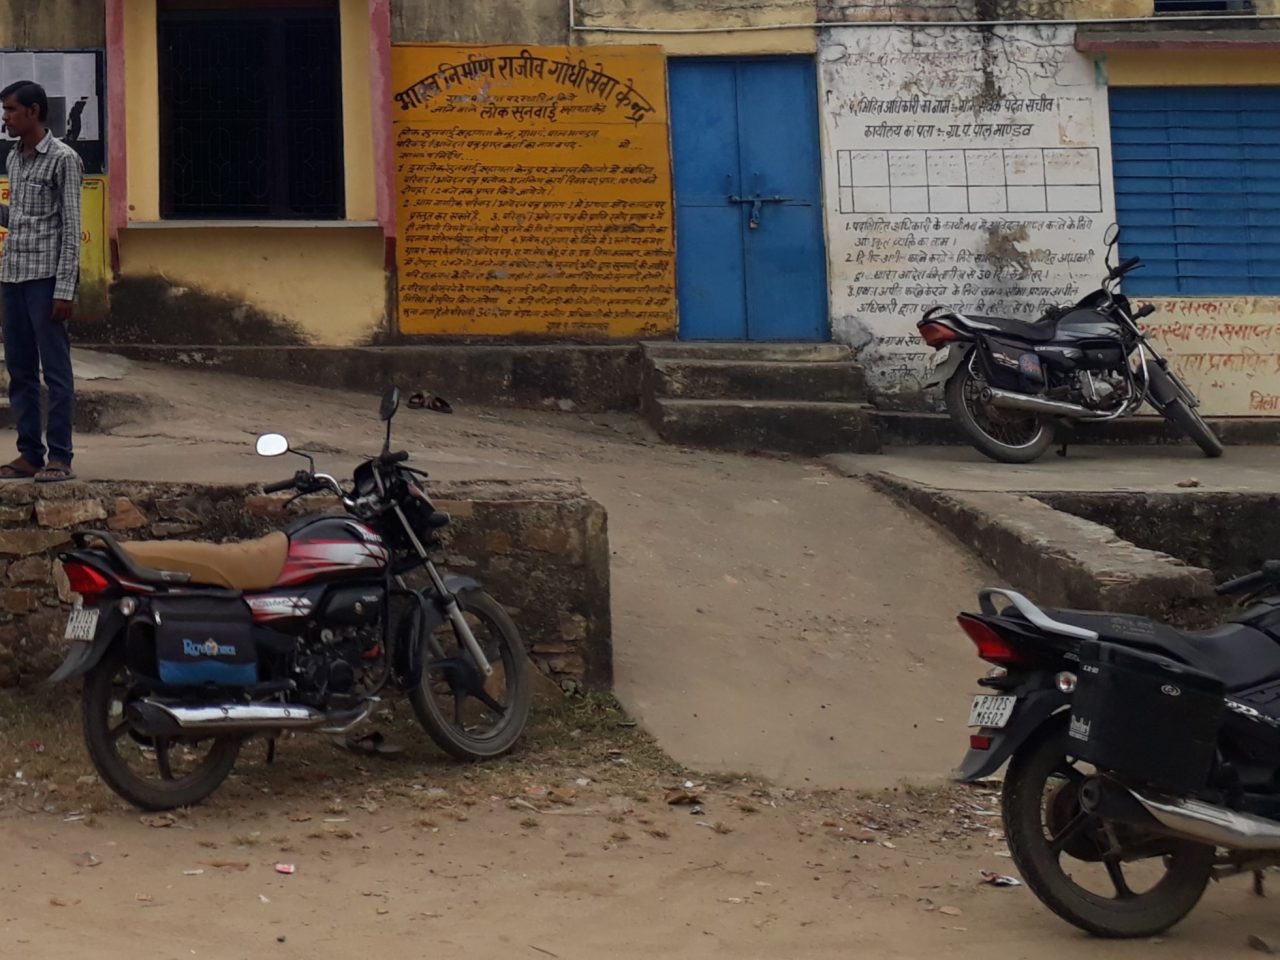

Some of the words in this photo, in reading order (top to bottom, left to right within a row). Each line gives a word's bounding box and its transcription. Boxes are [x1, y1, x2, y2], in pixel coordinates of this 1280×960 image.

[497, 49, 543, 80] राजीव
[584, 62, 619, 100] सेवा
[480, 102, 510, 120] लोक
[511, 101, 557, 123] सुनवाई
[972, 123, 993, 139] पाल
[993, 124, 1035, 139] माण्डव
[890, 217, 933, 233] अधिकारी
[856, 298, 898, 314] अधिकारी
[979, 696, 1010, 711] RJ12S
